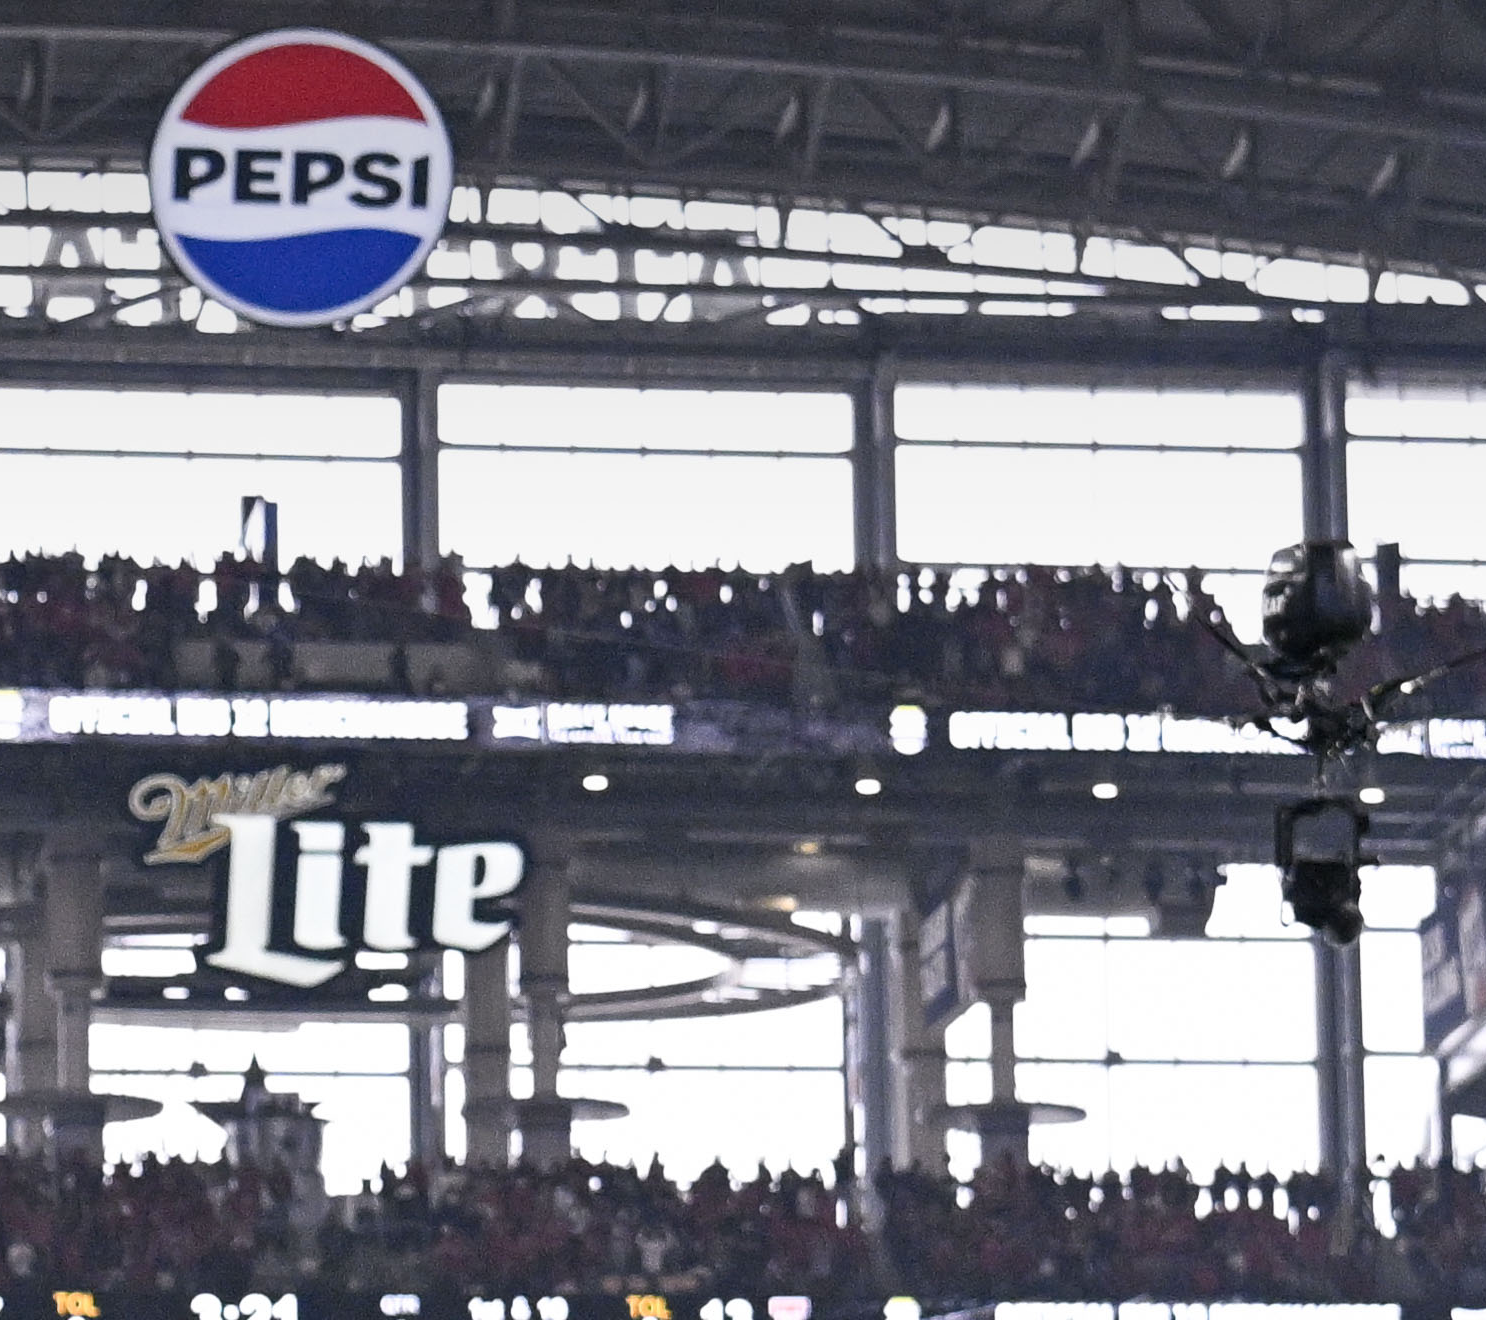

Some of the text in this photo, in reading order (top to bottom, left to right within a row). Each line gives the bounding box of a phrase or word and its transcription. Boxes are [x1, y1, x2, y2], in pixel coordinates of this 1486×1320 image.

[173, 146, 430, 210] PEPSI
[128, 763, 349, 866] Miller
[205, 812, 525, 989] Lite
[53, 1292, 101, 1318] TOL
